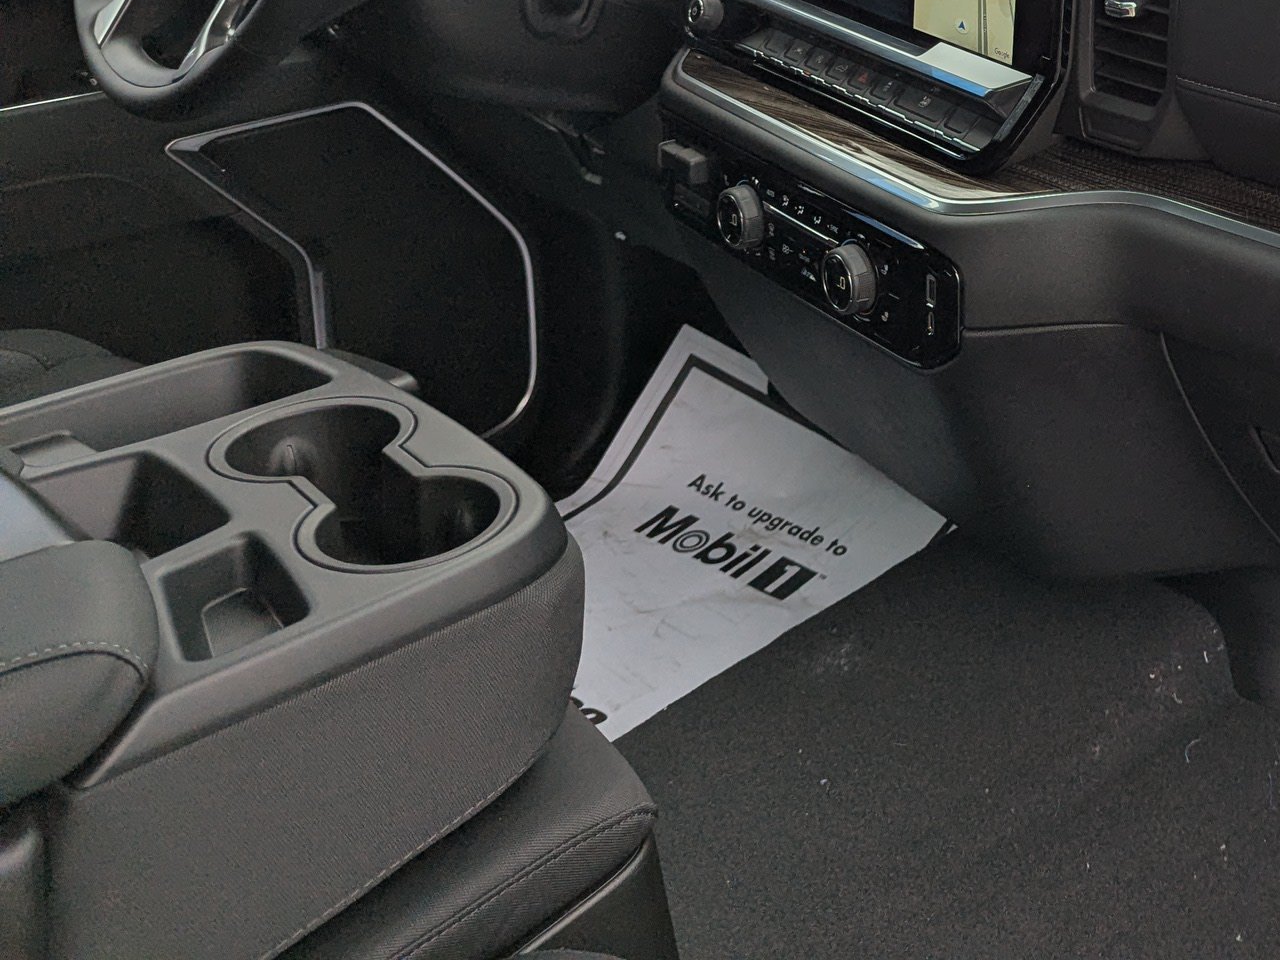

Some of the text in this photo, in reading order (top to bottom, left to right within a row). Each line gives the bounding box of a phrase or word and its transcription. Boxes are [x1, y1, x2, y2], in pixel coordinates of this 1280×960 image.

[994, 47, 1010, 60] Google
[633, 504, 773, 580] Mobil
[687, 473, 848, 556] Ask to upgrade to
